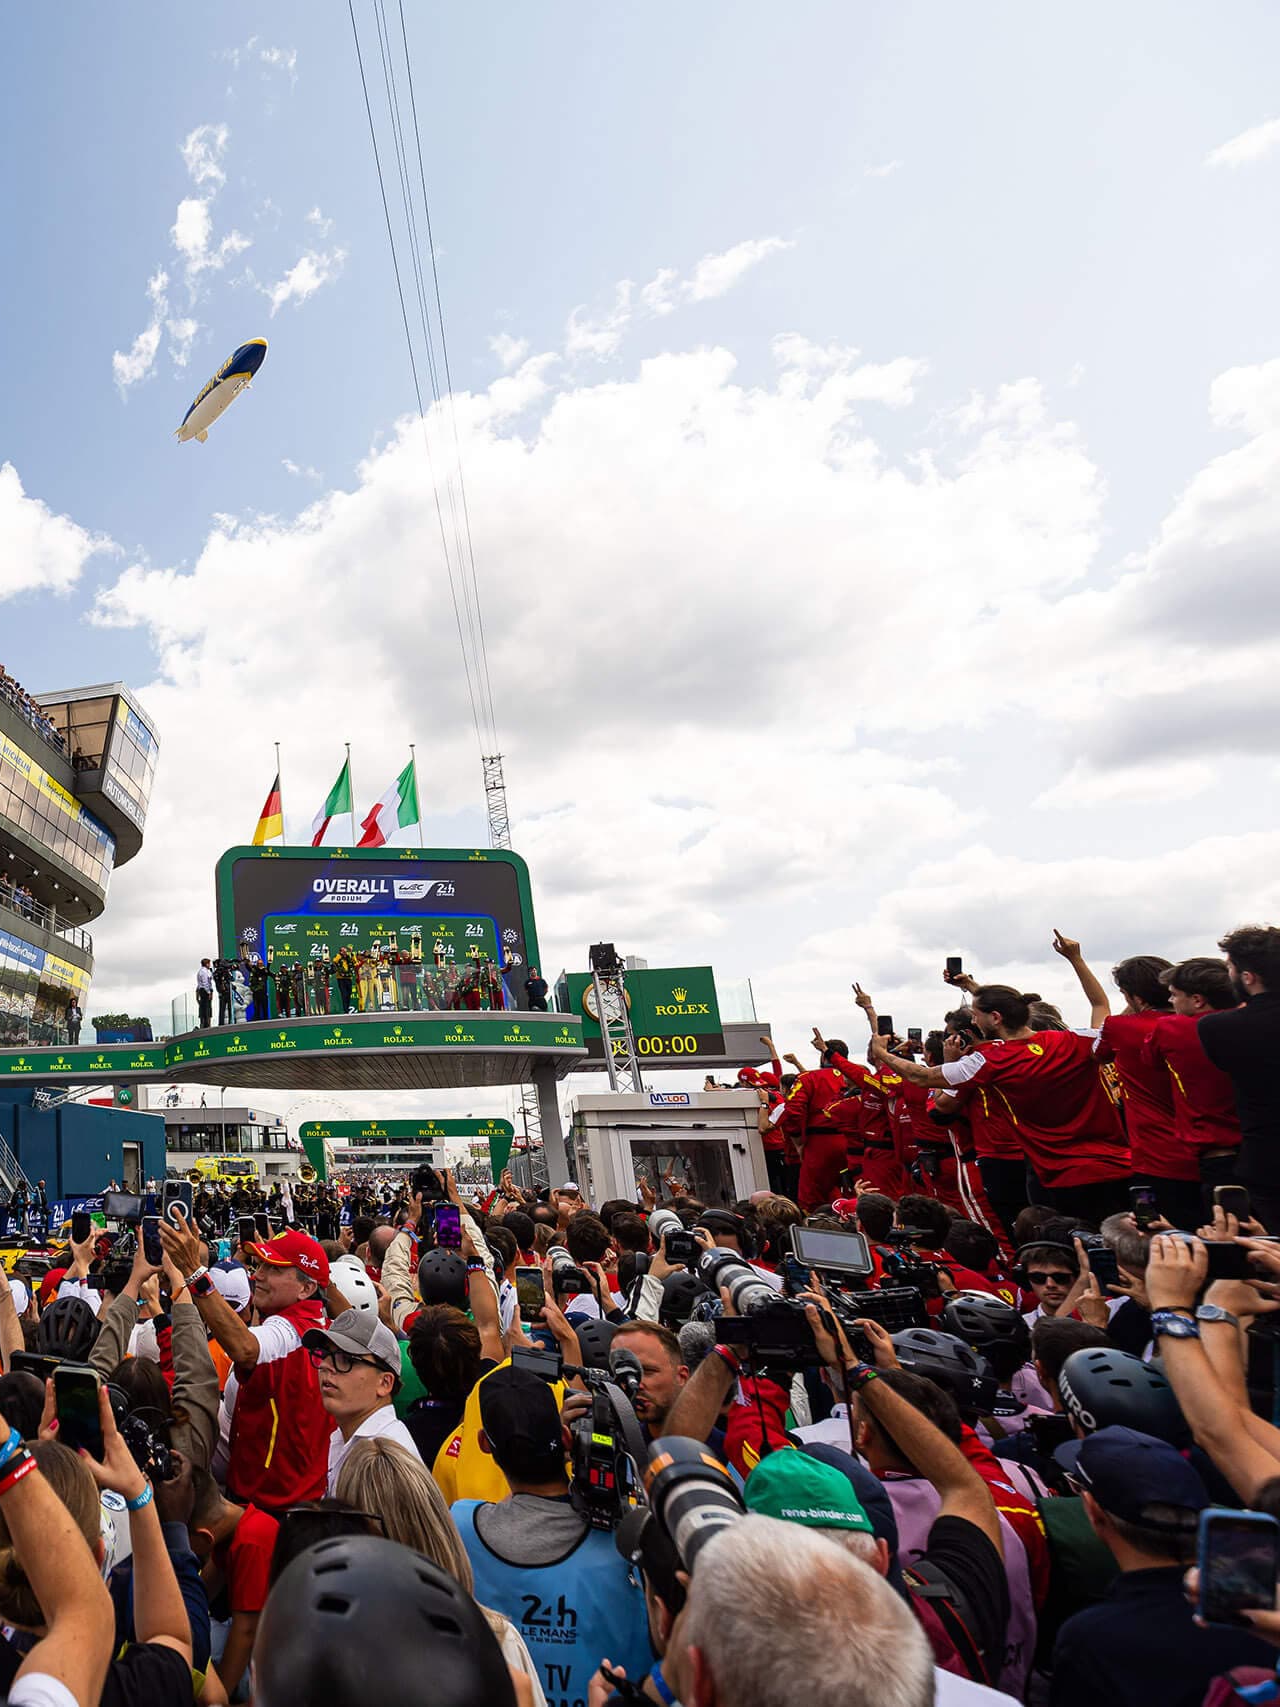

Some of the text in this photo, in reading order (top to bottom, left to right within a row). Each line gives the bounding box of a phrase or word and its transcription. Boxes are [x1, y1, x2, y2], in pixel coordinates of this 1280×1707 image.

[313, 878, 389, 894] OVERALL
[436, 883, 455, 894] 24h
[341, 922, 359, 933] 24h
[466, 923, 484, 933] 24h
[655, 1003, 710, 1016] ROLEX
[324, 1037, 353, 1046] ROLEX
[383, 1035, 414, 1044] ROLEX
[445, 1034, 475, 1042] ROLEX
[503, 1034, 531, 1042] ROLEX
[555, 1036, 577, 1044] ROLEX
[226, 1044, 248, 1053] ROLEX
[270, 1040, 297, 1049] ROLEX
[637, 1035, 698, 1054] 00:00
[194, 1049, 210, 1057] ROLEX
[50, 1063, 72, 1071] ROLEX
[361, 1129, 388, 1137] ROLEX
[781, 1506, 864, 1523] rene-binder.com
[521, 1594, 577, 1628] 24h
[521, 1626, 577, 1639] LE MANS
[544, 1663, 572, 1692] TV
